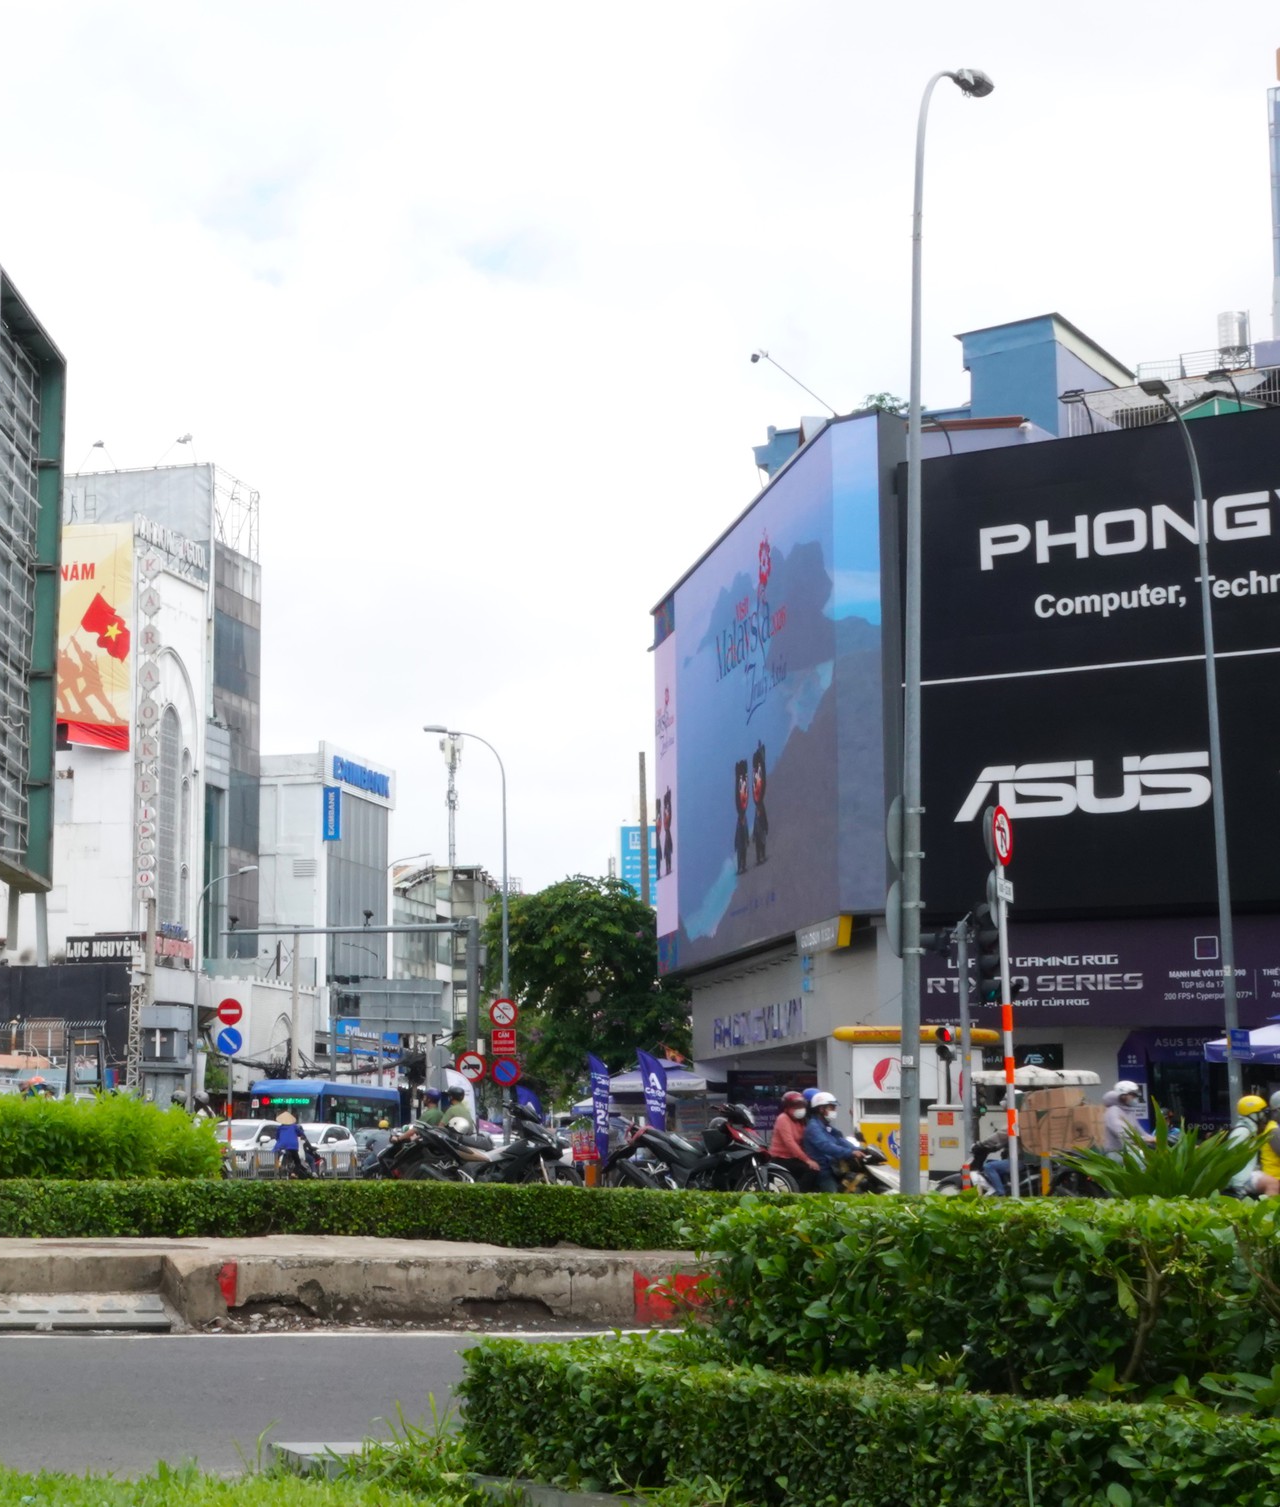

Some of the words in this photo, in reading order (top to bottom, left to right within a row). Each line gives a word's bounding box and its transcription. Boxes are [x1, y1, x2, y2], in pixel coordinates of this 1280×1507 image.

[979, 489, 1280, 571] PHONG
[1034, 583, 1187, 618] Computer,
[953, 750, 1212, 823] ASUS
[66, 941, 90, 962] LỤC
[1016, 956, 1079, 968] GAMING
[1082, 954, 1119, 966] ROG
[1036, 973, 1144, 992] SERIES
[1066, 999, 1090, 1007] ROG
